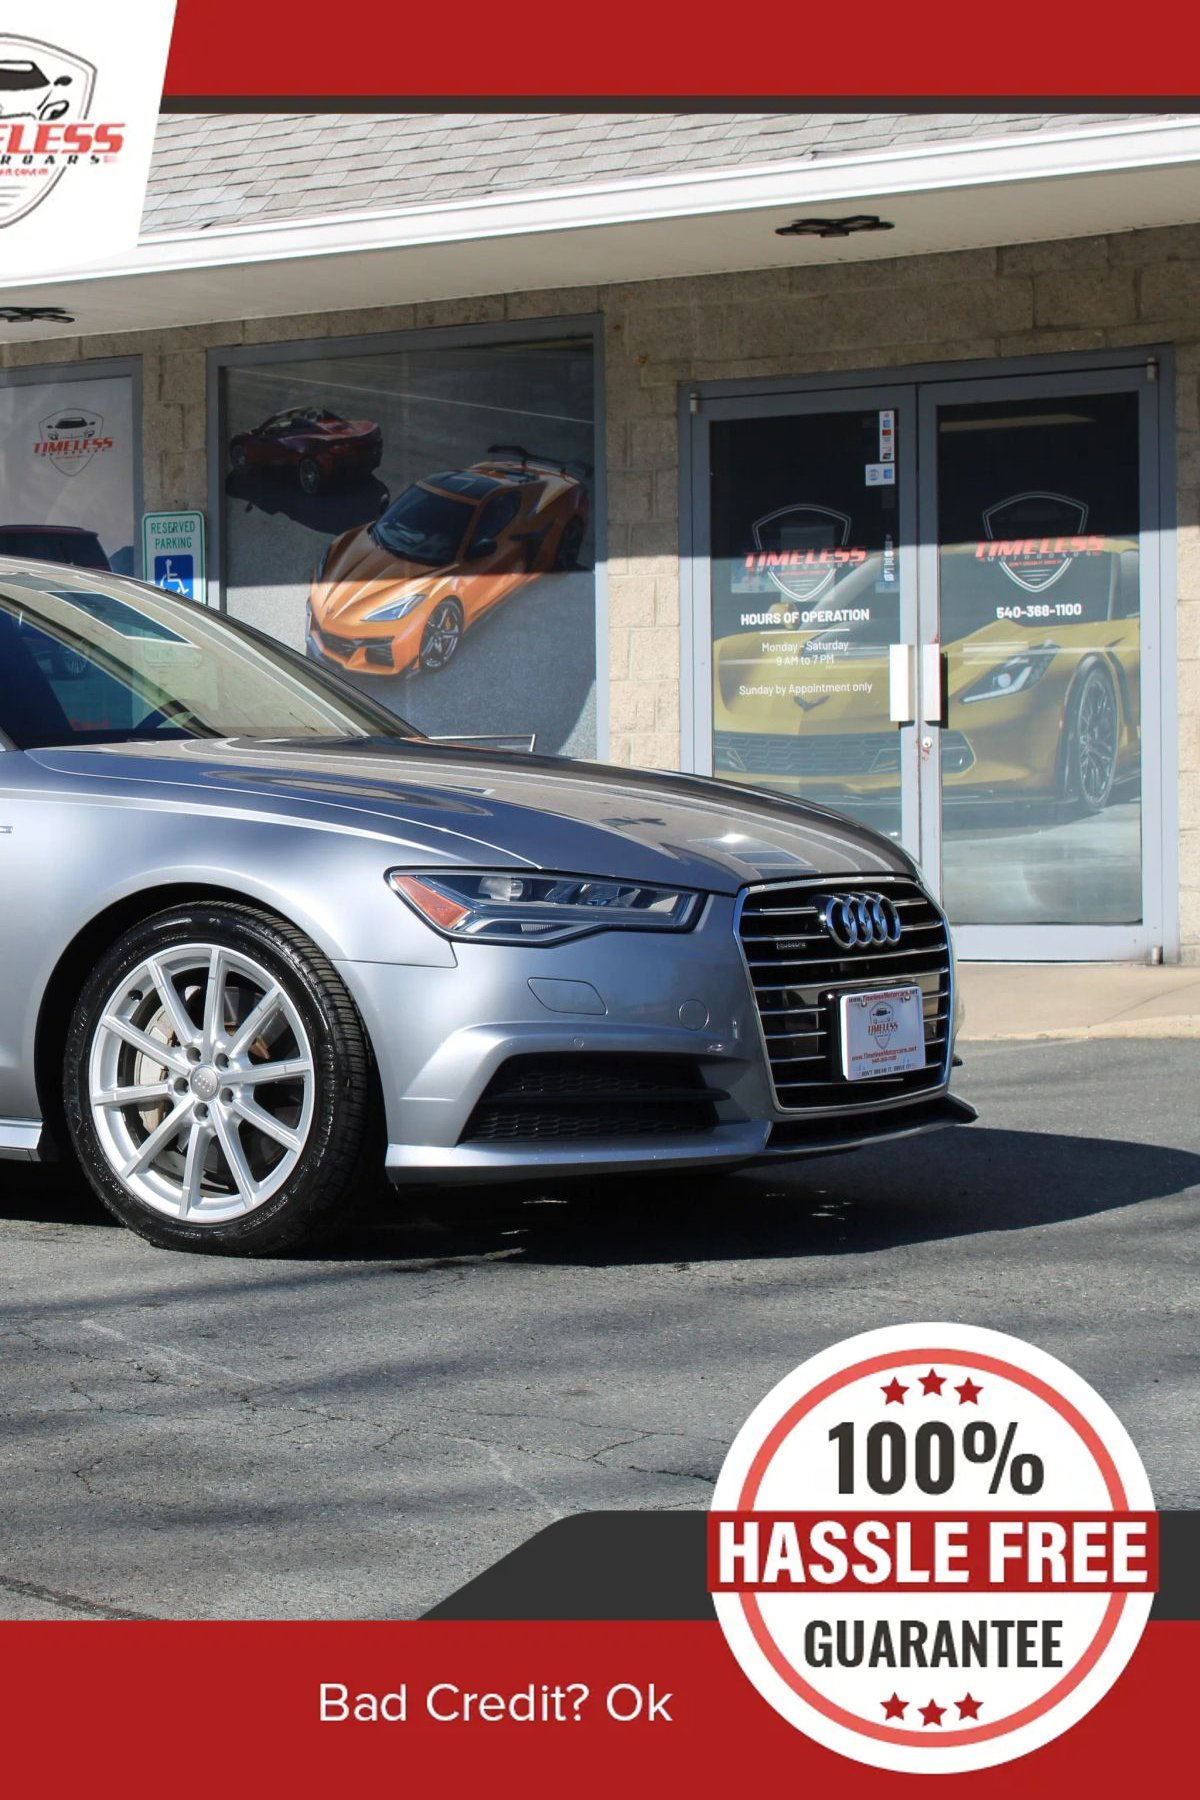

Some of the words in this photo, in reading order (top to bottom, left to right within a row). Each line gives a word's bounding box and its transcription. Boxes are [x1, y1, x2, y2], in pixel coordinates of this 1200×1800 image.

[32, 436, 113, 454] TIMELESS
[150, 520, 196, 534] RESERVED
[154, 536, 193, 550] PARKING
[974, 534, 1105, 558] TIMELESS
[744, 546, 867, 569] TIMELESS
[740, 613, 781, 626] HOURS
[783, 611, 800, 624] OF
[801, 608, 870, 623] OPERATION
[996, 603, 1082, 618] 540-368-1100
[761, 642, 798, 654] Monday
[805, 640, 849, 653] Saturday
[784, 657, 799, 666] AM
[800, 655, 811, 666] to
[813, 655, 819, 665] 7
[820, 654, 835, 665] PM
[739, 685, 775, 697] Sunday
[775, 684, 787, 697] by
[788, 683, 851, 696] Appointment
[852, 682, 873, 694] only
